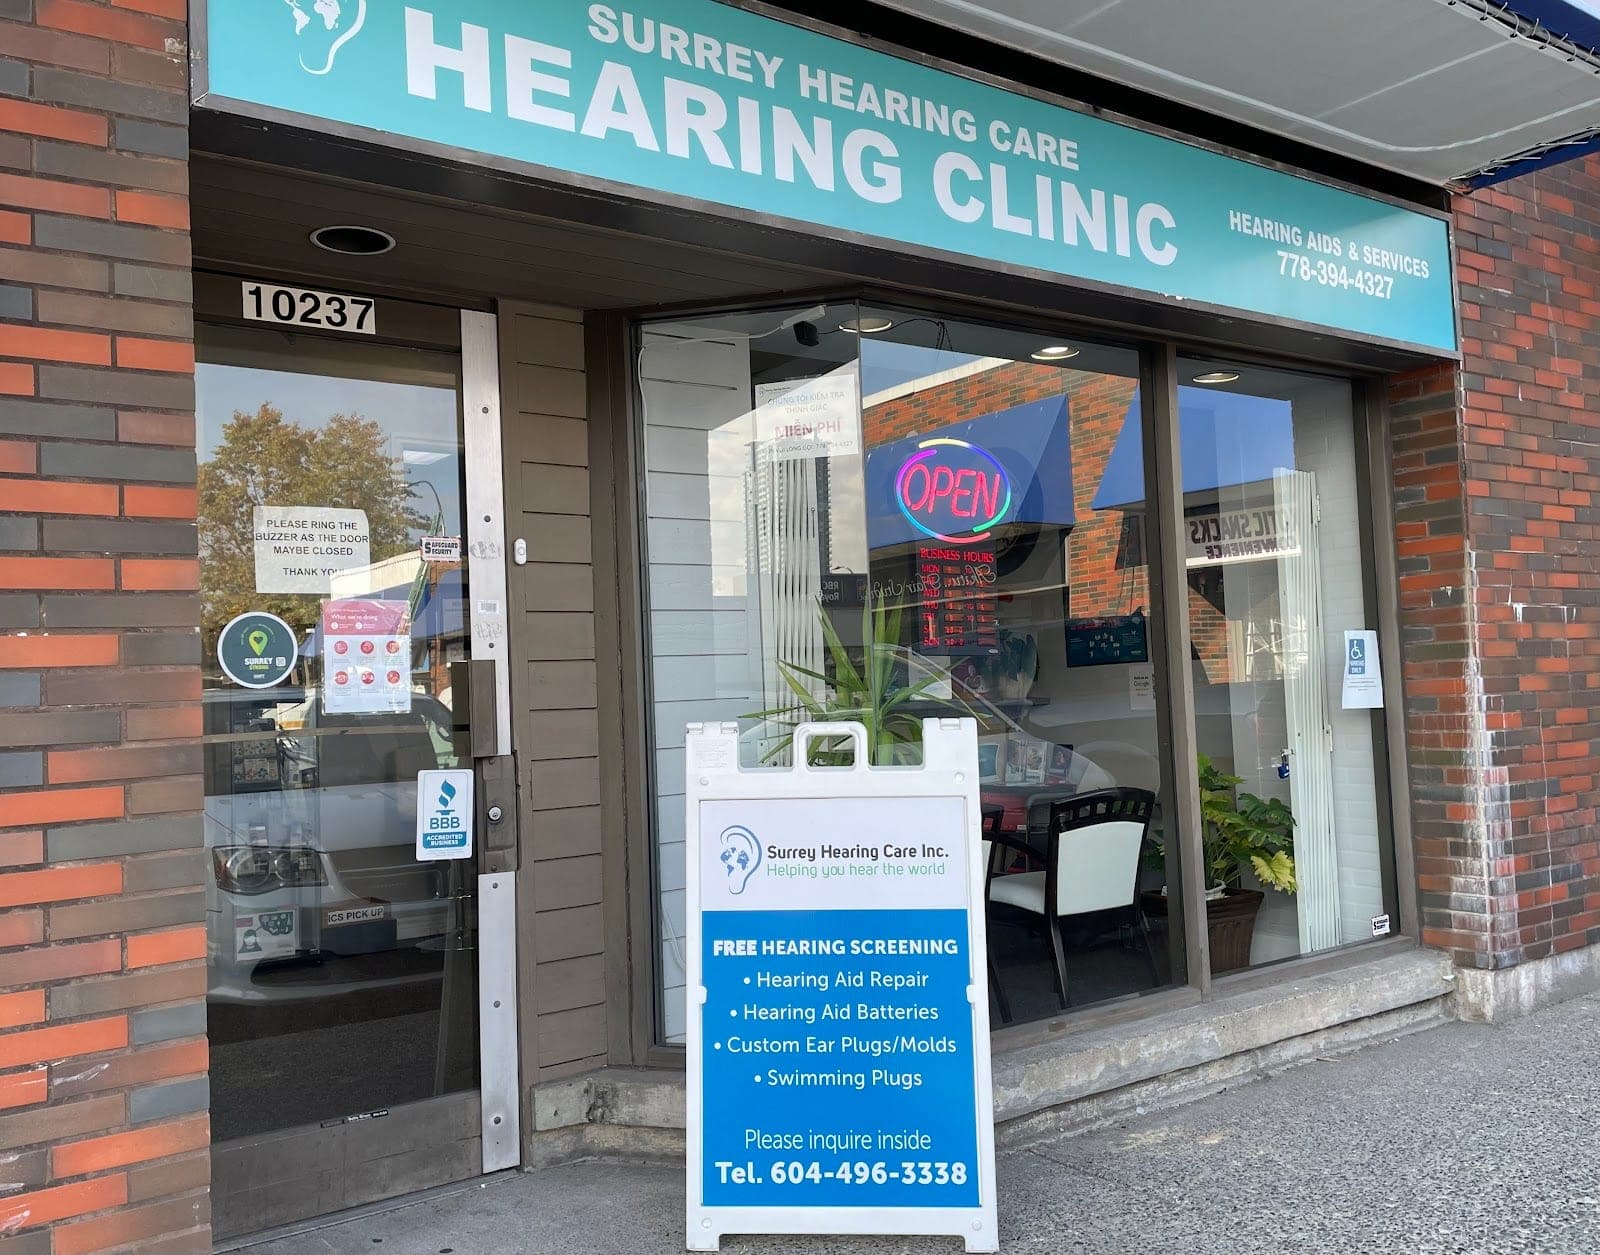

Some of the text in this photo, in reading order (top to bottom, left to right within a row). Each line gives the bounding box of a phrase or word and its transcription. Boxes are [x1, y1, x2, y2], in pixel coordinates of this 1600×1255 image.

[587, 3, 1080, 171] SURREY HEARING CARE
[404, 6, 1178, 266] HEARING CLINIC
[1229, 210, 1430, 279] HEARING AIDS & SERVICES
[1277, 250, 1393, 299] 778-394-4327
[248, 286, 373, 330] 10237
[903, 463, 1000, 518] OPEN
[267, 519, 358, 531] PLEASE RING THE
[255, 532, 369, 543] BUZZER AS THE DOOR
[273, 546, 353, 556] MAYBE CLOSED
[920, 548, 994, 562] BUSINESS HOURS
[283, 567, 318, 576] THANK
[922, 564, 939, 573] MON
[244, 657, 273, 666] SURREY
[430, 817, 460, 829] BBB
[767, 844, 949, 861] Surrey Hearing Care Inc.
[767, 862, 946, 878] Helping you hear the world
[346, 911, 368, 921] PICK
[370, 908, 384, 917] UP
[713, 939, 958, 956] FREE HEARING SCREENING
[757, 971, 929, 991] Hearing Aid Repair
[744, 1004, 939, 1024] Hearing Aid Batteries
[727, 1036, 957, 1056] Custom Ear Plugs/Molds
[767, 1070, 923, 1089] Swimming Plugs
[745, 1129, 932, 1154] Please inquire inside
[715, 1161, 968, 1185] Tel. 604-496-3338
